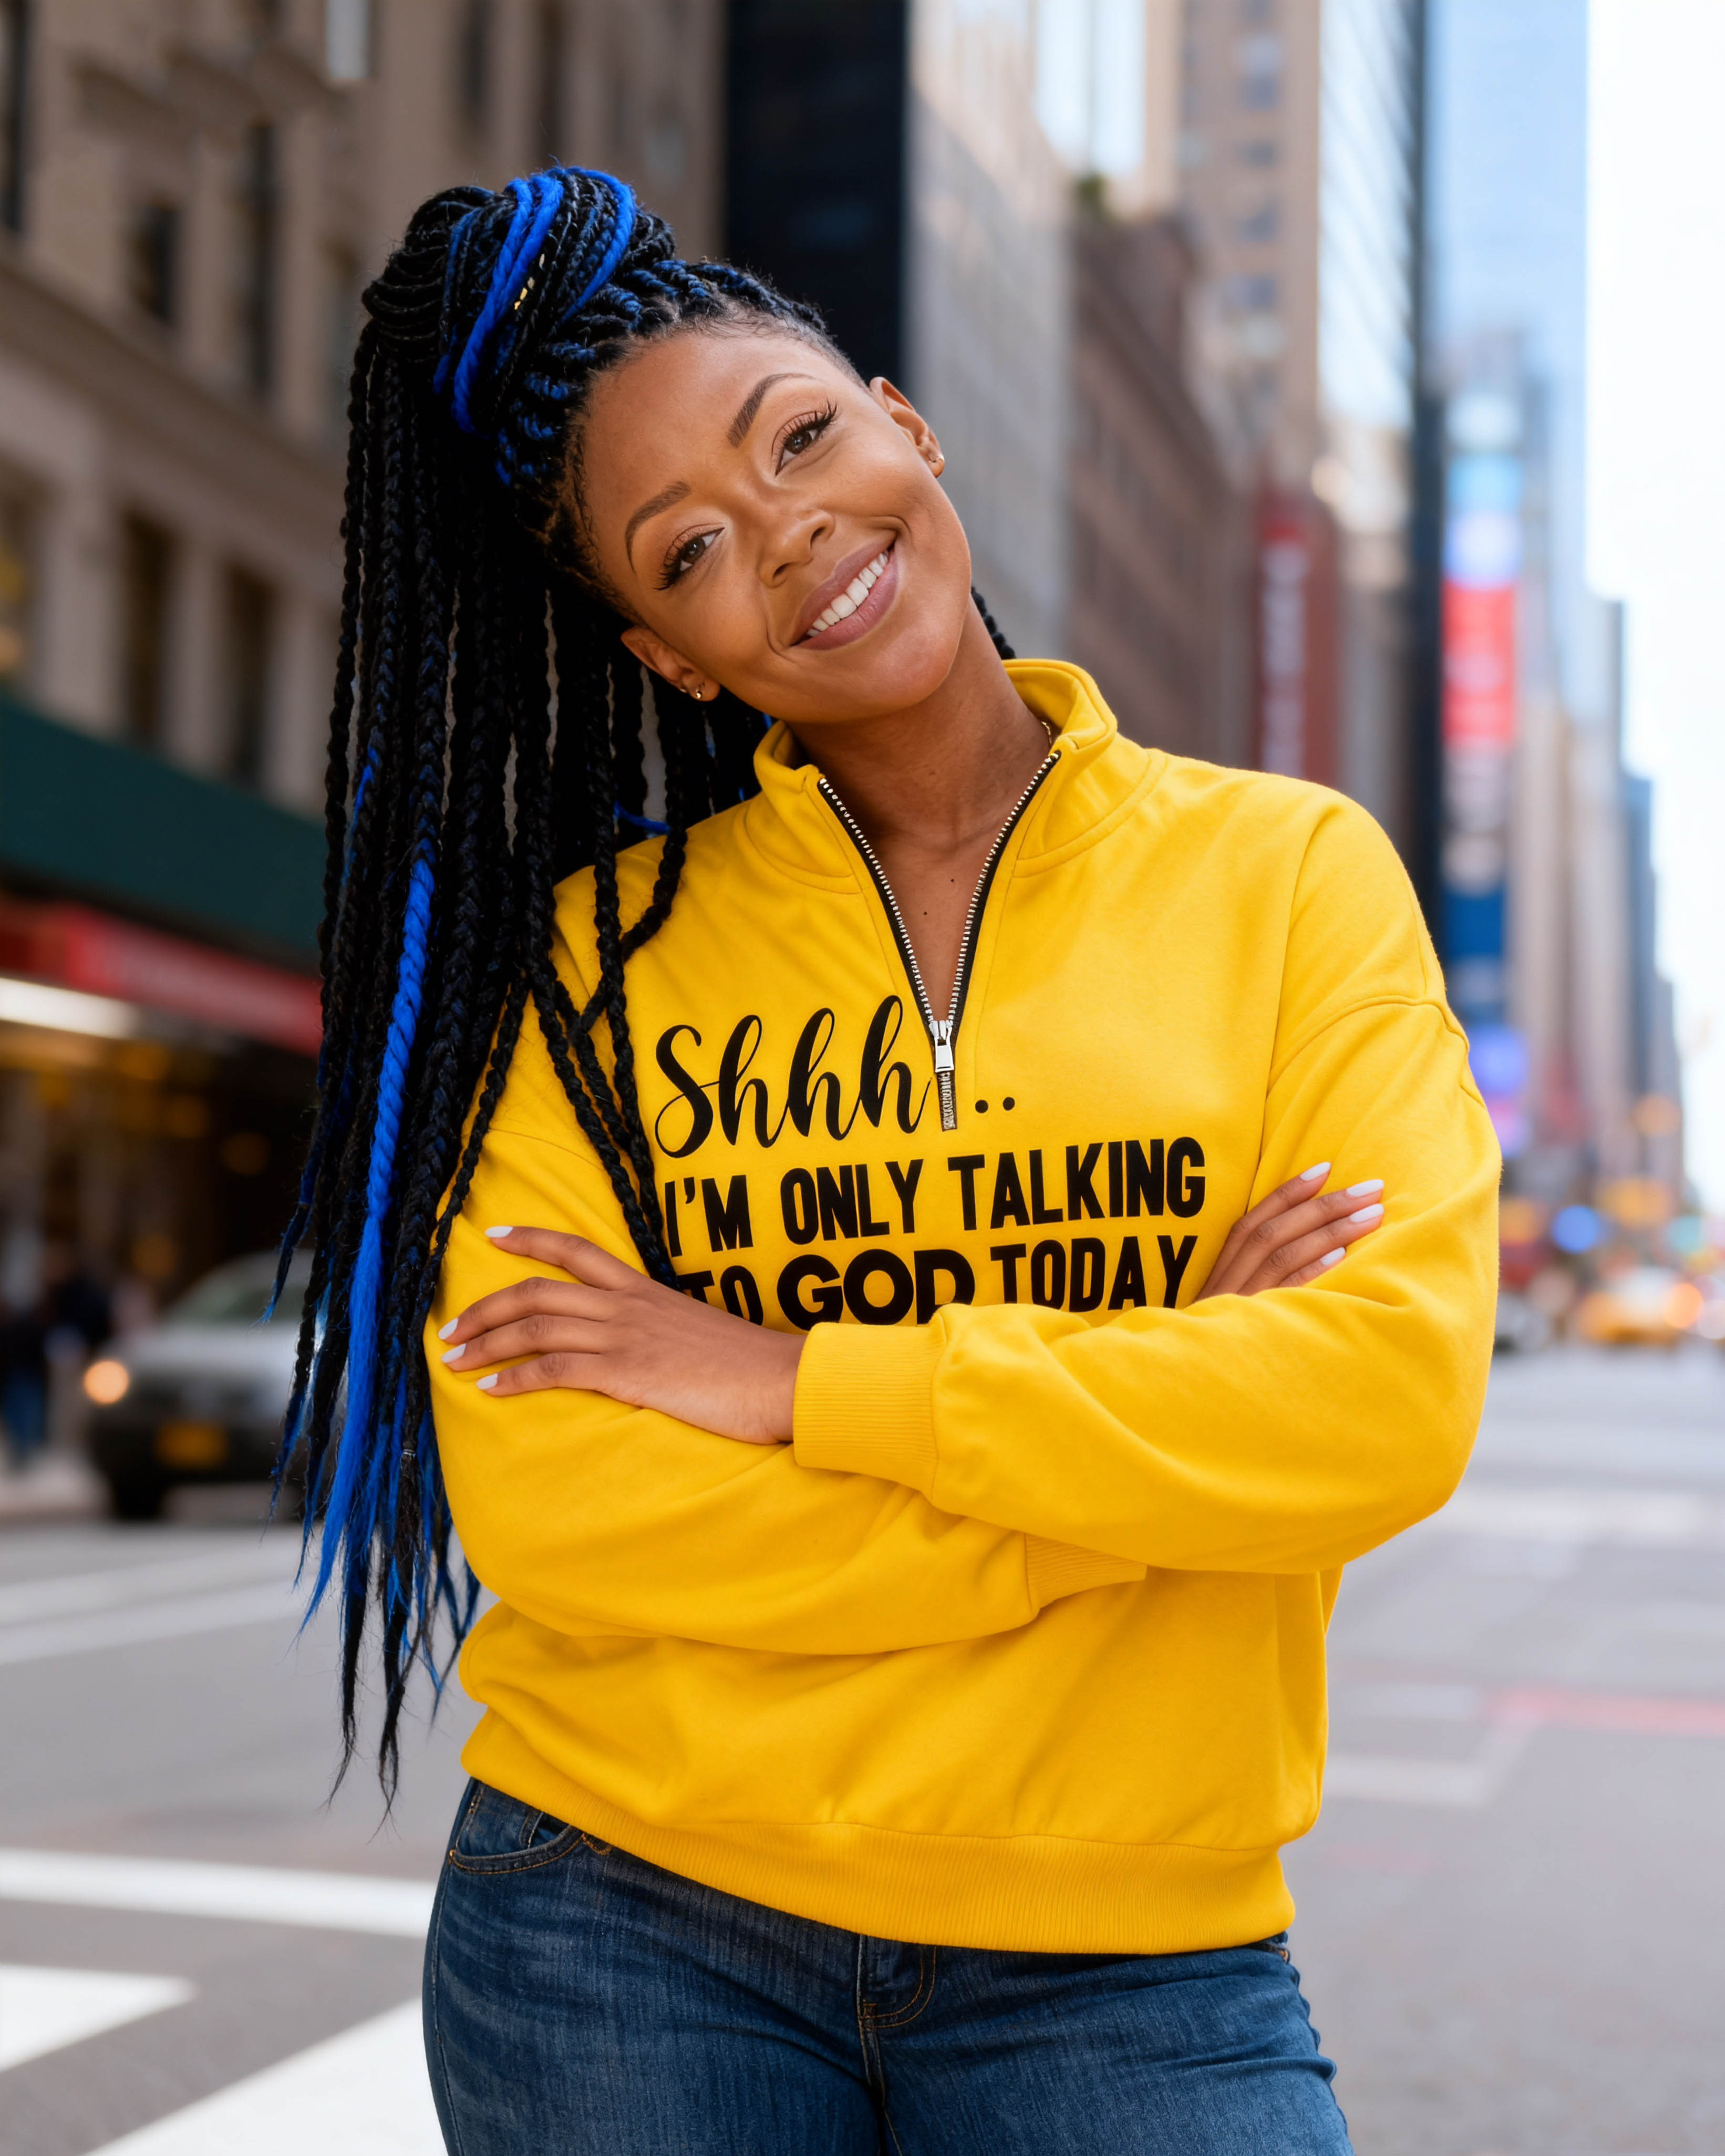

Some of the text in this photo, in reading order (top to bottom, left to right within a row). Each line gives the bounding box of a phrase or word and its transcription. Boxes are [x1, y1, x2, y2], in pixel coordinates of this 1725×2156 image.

[664, 1137, 1205, 1257] I'M ONLY TALKING
[777, 1248, 976, 1332] GOD
[990, 1235, 1198, 1313] TODAY
